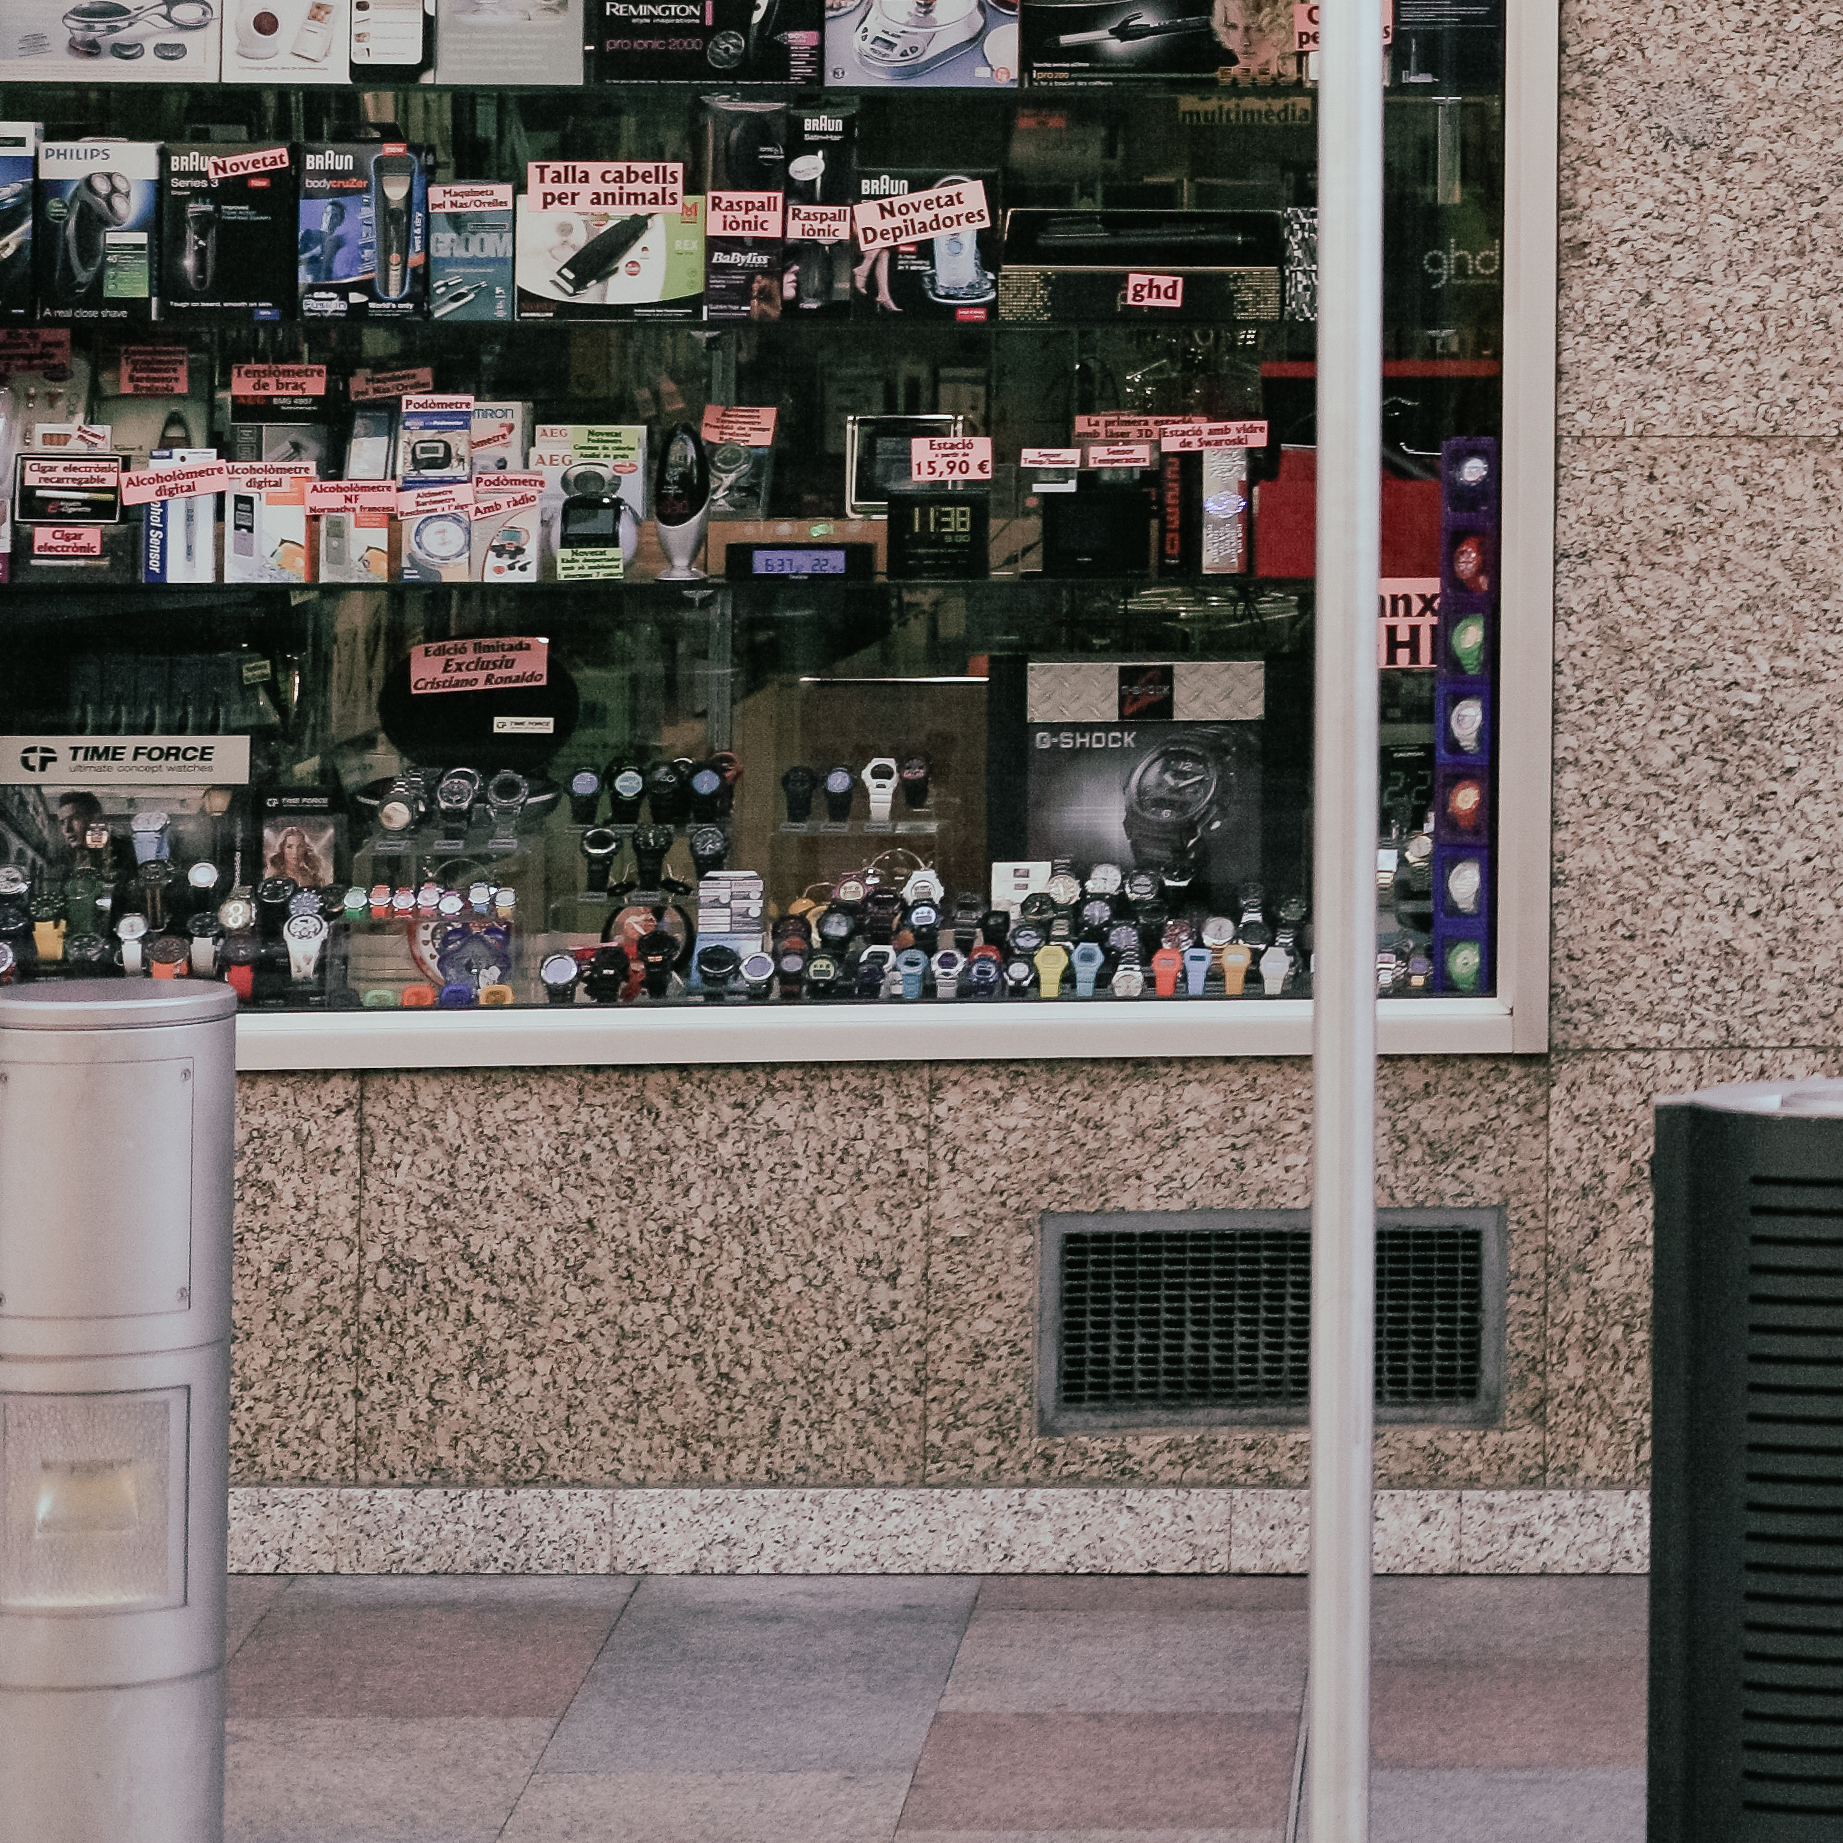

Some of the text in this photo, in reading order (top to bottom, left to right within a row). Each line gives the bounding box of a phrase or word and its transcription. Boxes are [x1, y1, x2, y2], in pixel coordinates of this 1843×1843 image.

[606, 2, 701, 17] REMINGTON
[804, 116, 842, 132] BRAUN
[44, 148, 110, 162] PHILIPS
[212, 151, 287, 176] Novetat
[306, 151, 354, 171] BRAUN
[536, 165, 678, 185] Talla cabells
[861, 176, 908, 195] BRAUN
[542, 187, 678, 209] per animals
[711, 195, 778, 215] Raspall
[877, 191, 964, 221] Novetat
[792, 209, 847, 223] Raspall
[862, 209, 986, 245] Depiladores
[1132, 278, 1178, 303] ghd
[235, 367, 324, 380] Tensiòmetre
[1179, 435, 1248, 449] de Swaroski
[915, 460, 989, 478] 15,90 €
[155, 481, 196, 498] digital
[246, 476, 282, 491] digital
[442, 655, 515, 674] Exclusiu
[413, 670, 543, 692] Cristiano Ronaldo
[69, 745, 215, 762] TIME FORCE
[69, 763, 214, 776] ultimate concept watches
